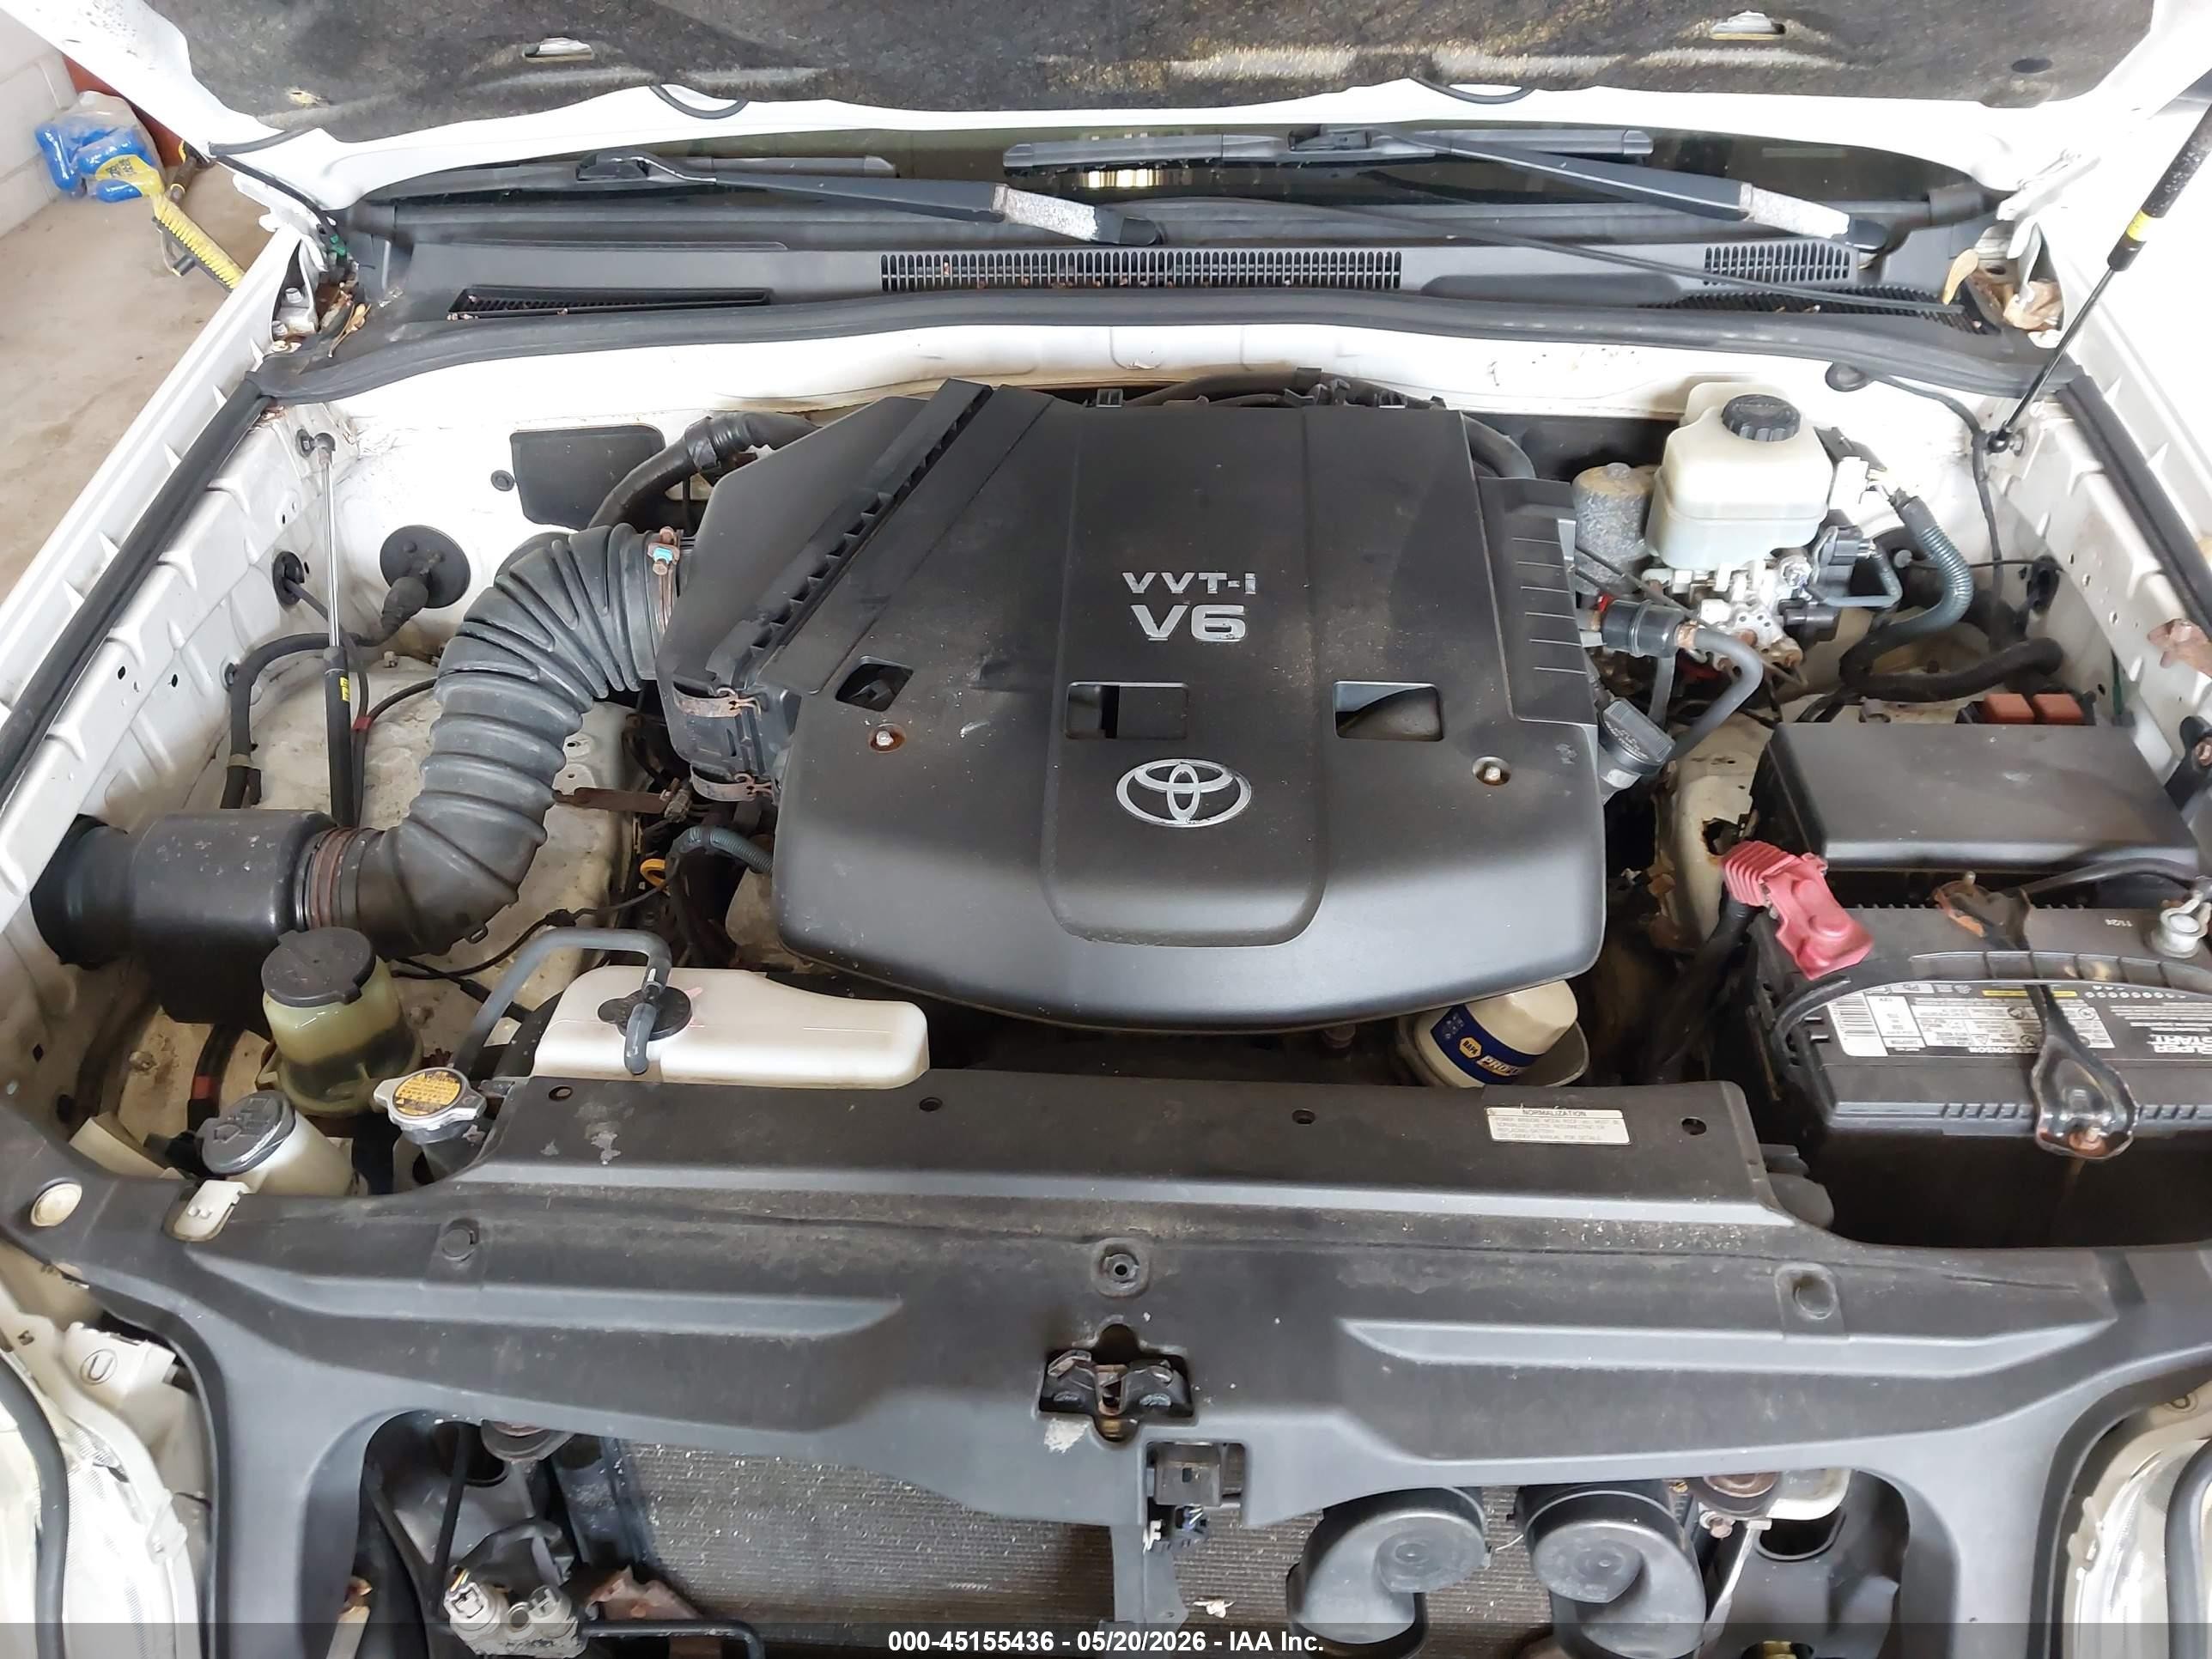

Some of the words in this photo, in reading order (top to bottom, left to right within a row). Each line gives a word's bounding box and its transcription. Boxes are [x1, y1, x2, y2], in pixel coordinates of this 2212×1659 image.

[1130, 605, 1246, 642] V6
[2149, 1035, 2212, 1045] START
[2154, 1044, 2212, 1055] SUPER
[1522, 1109, 1587, 1117] NORMALIZATION
